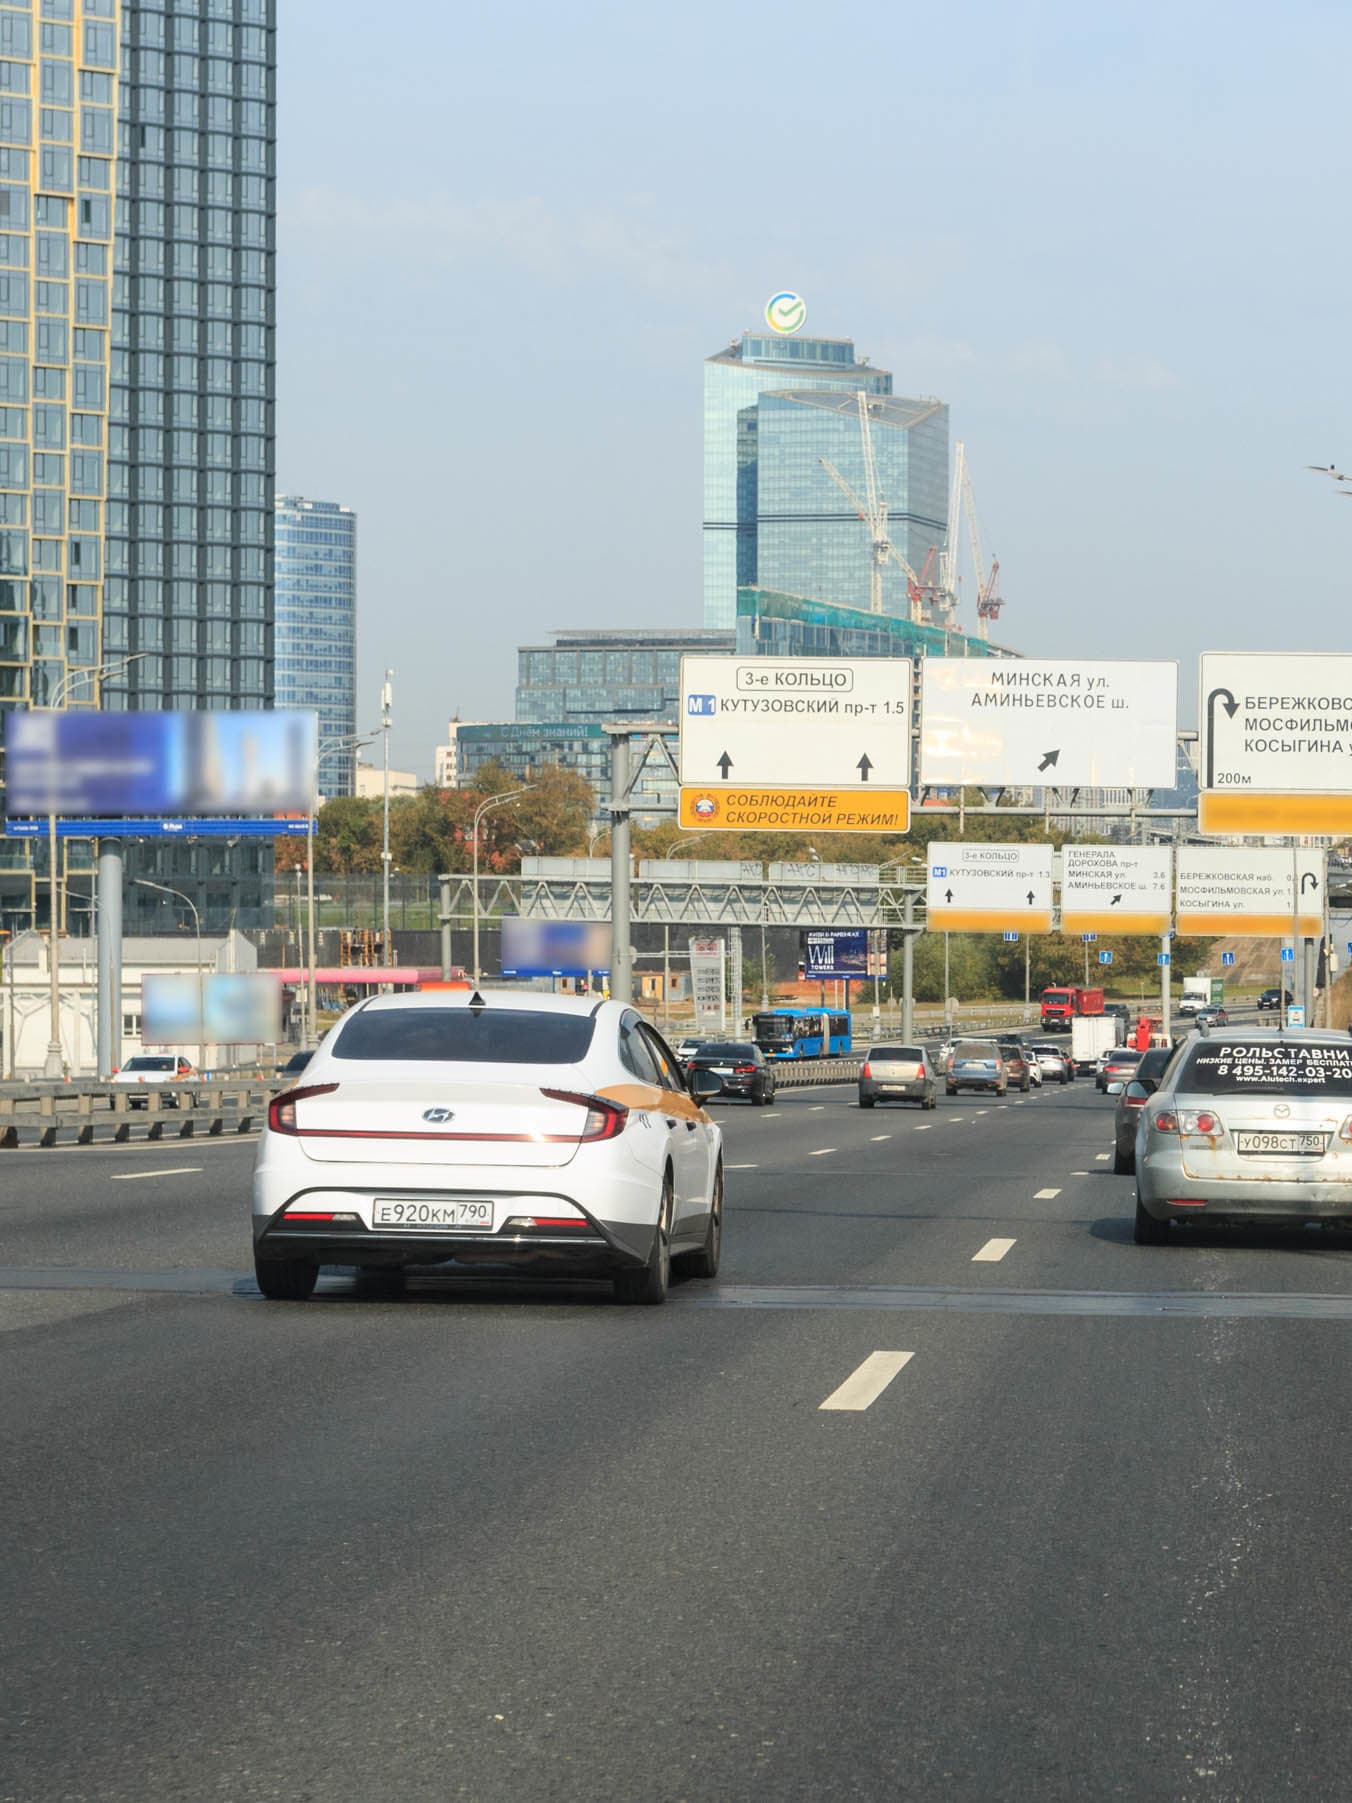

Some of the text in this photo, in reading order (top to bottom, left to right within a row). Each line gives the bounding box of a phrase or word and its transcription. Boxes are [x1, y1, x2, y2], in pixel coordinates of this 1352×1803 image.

[745, 672, 847, 688] 3-е КОЛЬЦО
[991, 672, 1110, 690] МИНСКАЯ ул.
[720, 697, 839, 714] КУТУЗОВСКИЙ
[844, 702, 878, 716] пр-т
[884, 702, 904, 714] 1.5
[971, 692, 1129, 709] АМИНЬЕВСКОЕ ш.
[1244, 739, 1344, 753] КОСЫГИНА
[1217, 772, 1252, 784] 200м
[726, 794, 838, 810] СОБЛЮДАЙТЕ
[726, 812, 898, 826] СКОРОСТНОЙ РЕЖИМ!
[980, 852, 1018, 862] КОЛЬЦО
[1068, 850, 1116, 858] ГЕНЕРАЛА
[1068, 860, 1138, 870] ДОРОХОВА пр-т
[950, 868, 1014, 878] КУТУЗОВСКИЙ
[1016, 871, 1034, 880] пр-т
[1068, 870, 1112, 878] МИНСКАЯ
[1180, 872, 1254, 881] БЕРЕЖКОВСКАЯ
[1068, 882, 1136, 890] АМИНЬЕВСКОЕ
[1180, 886, 1271, 895] МОСФИЛЬМОВСКАЯ
[1180, 900, 1230, 908] КОСЫГИНА
[808, 945, 834, 964] Will
[1220, 1047, 1349, 1060] РОЛЬСТАВНИ
[1218, 1065, 1352, 1078] 8 495-142-03-20
[1300, 1136, 1320, 1146] 750
[381, 1204, 486, 1222] Е920КМ 790
